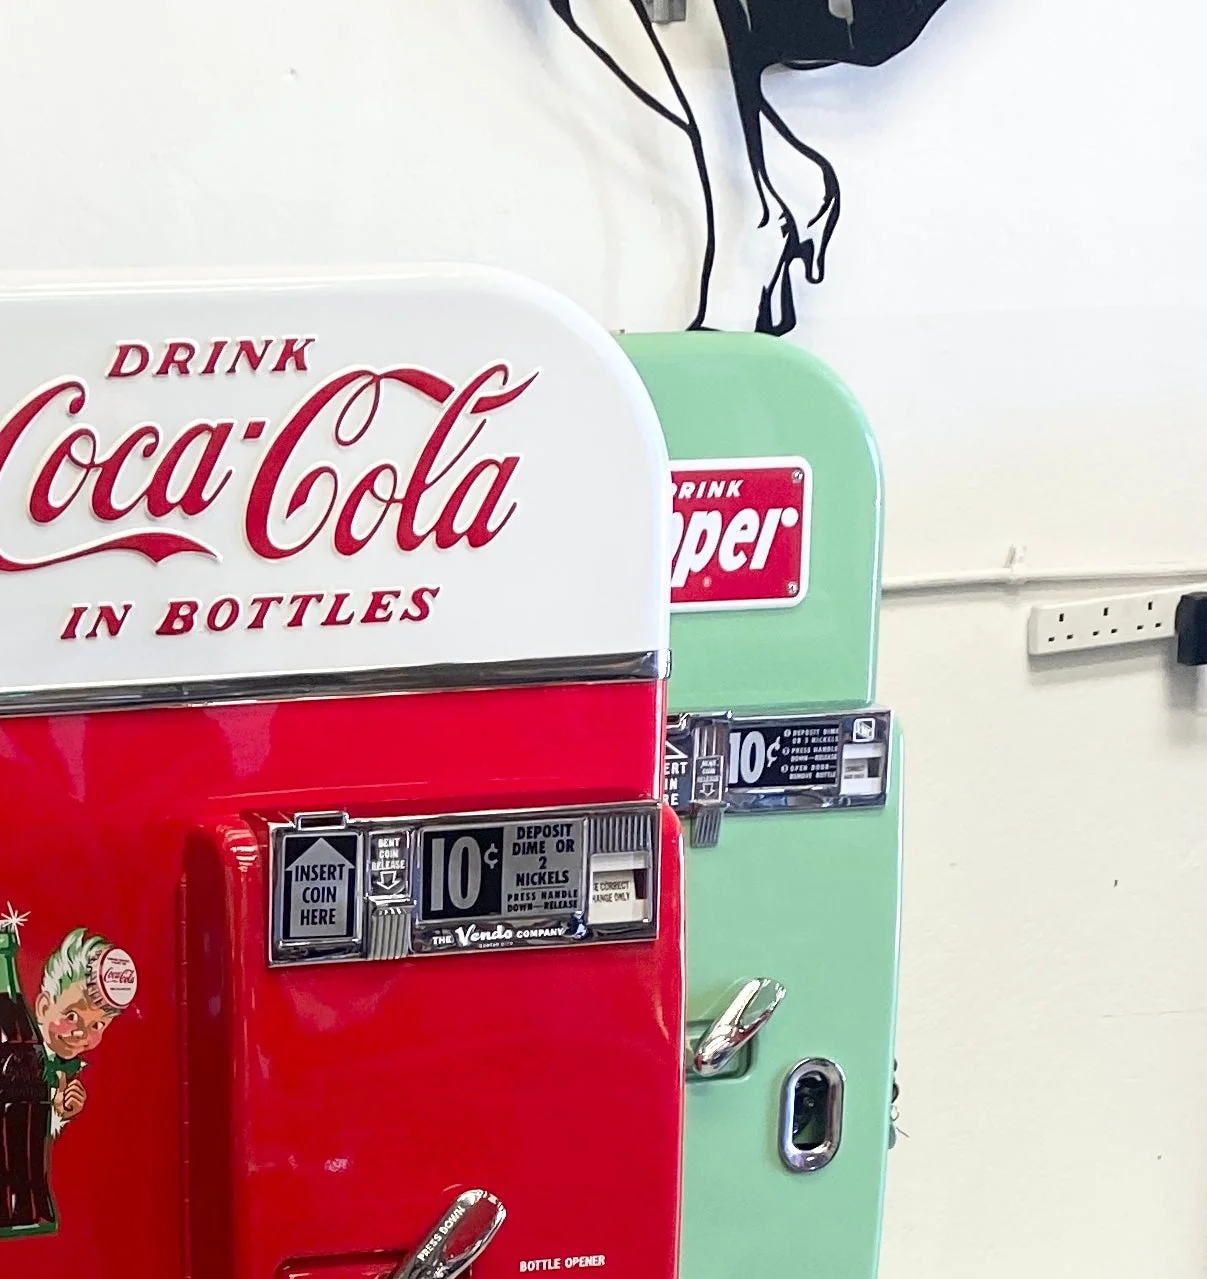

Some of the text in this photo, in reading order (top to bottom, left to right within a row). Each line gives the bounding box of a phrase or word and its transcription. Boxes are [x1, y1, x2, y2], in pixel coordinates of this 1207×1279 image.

[106, 337, 316, 379] DRINK
[61, 586, 441, 640] IN BOTTLES
[729, 731, 781, 784] 10¢
[664, 762, 688, 775] ERT
[665, 778, 678, 790] IN
[517, 824, 573, 840] DEPOSIT
[379, 850, 398, 858] COIN
[512, 840, 574, 856] DIME OR
[539, 857, 547, 869] 2
[295, 863, 345, 882] INSERT
[431, 836, 499, 911] 10¢
[516, 870, 569, 887] NICKELS
[302, 886, 337, 904] COIN
[508, 889, 578, 901] PRESS HANDLE
[300, 909, 336, 926] HERE
[432, 936, 452, 945] THE
[455, 924, 512, 946] Vendo
[516, 928, 564, 939] COMPANY
[417, 1205, 466, 1261] PRESS DOWN
[520, 1255, 605, 1272] BOTTLE OPENER
